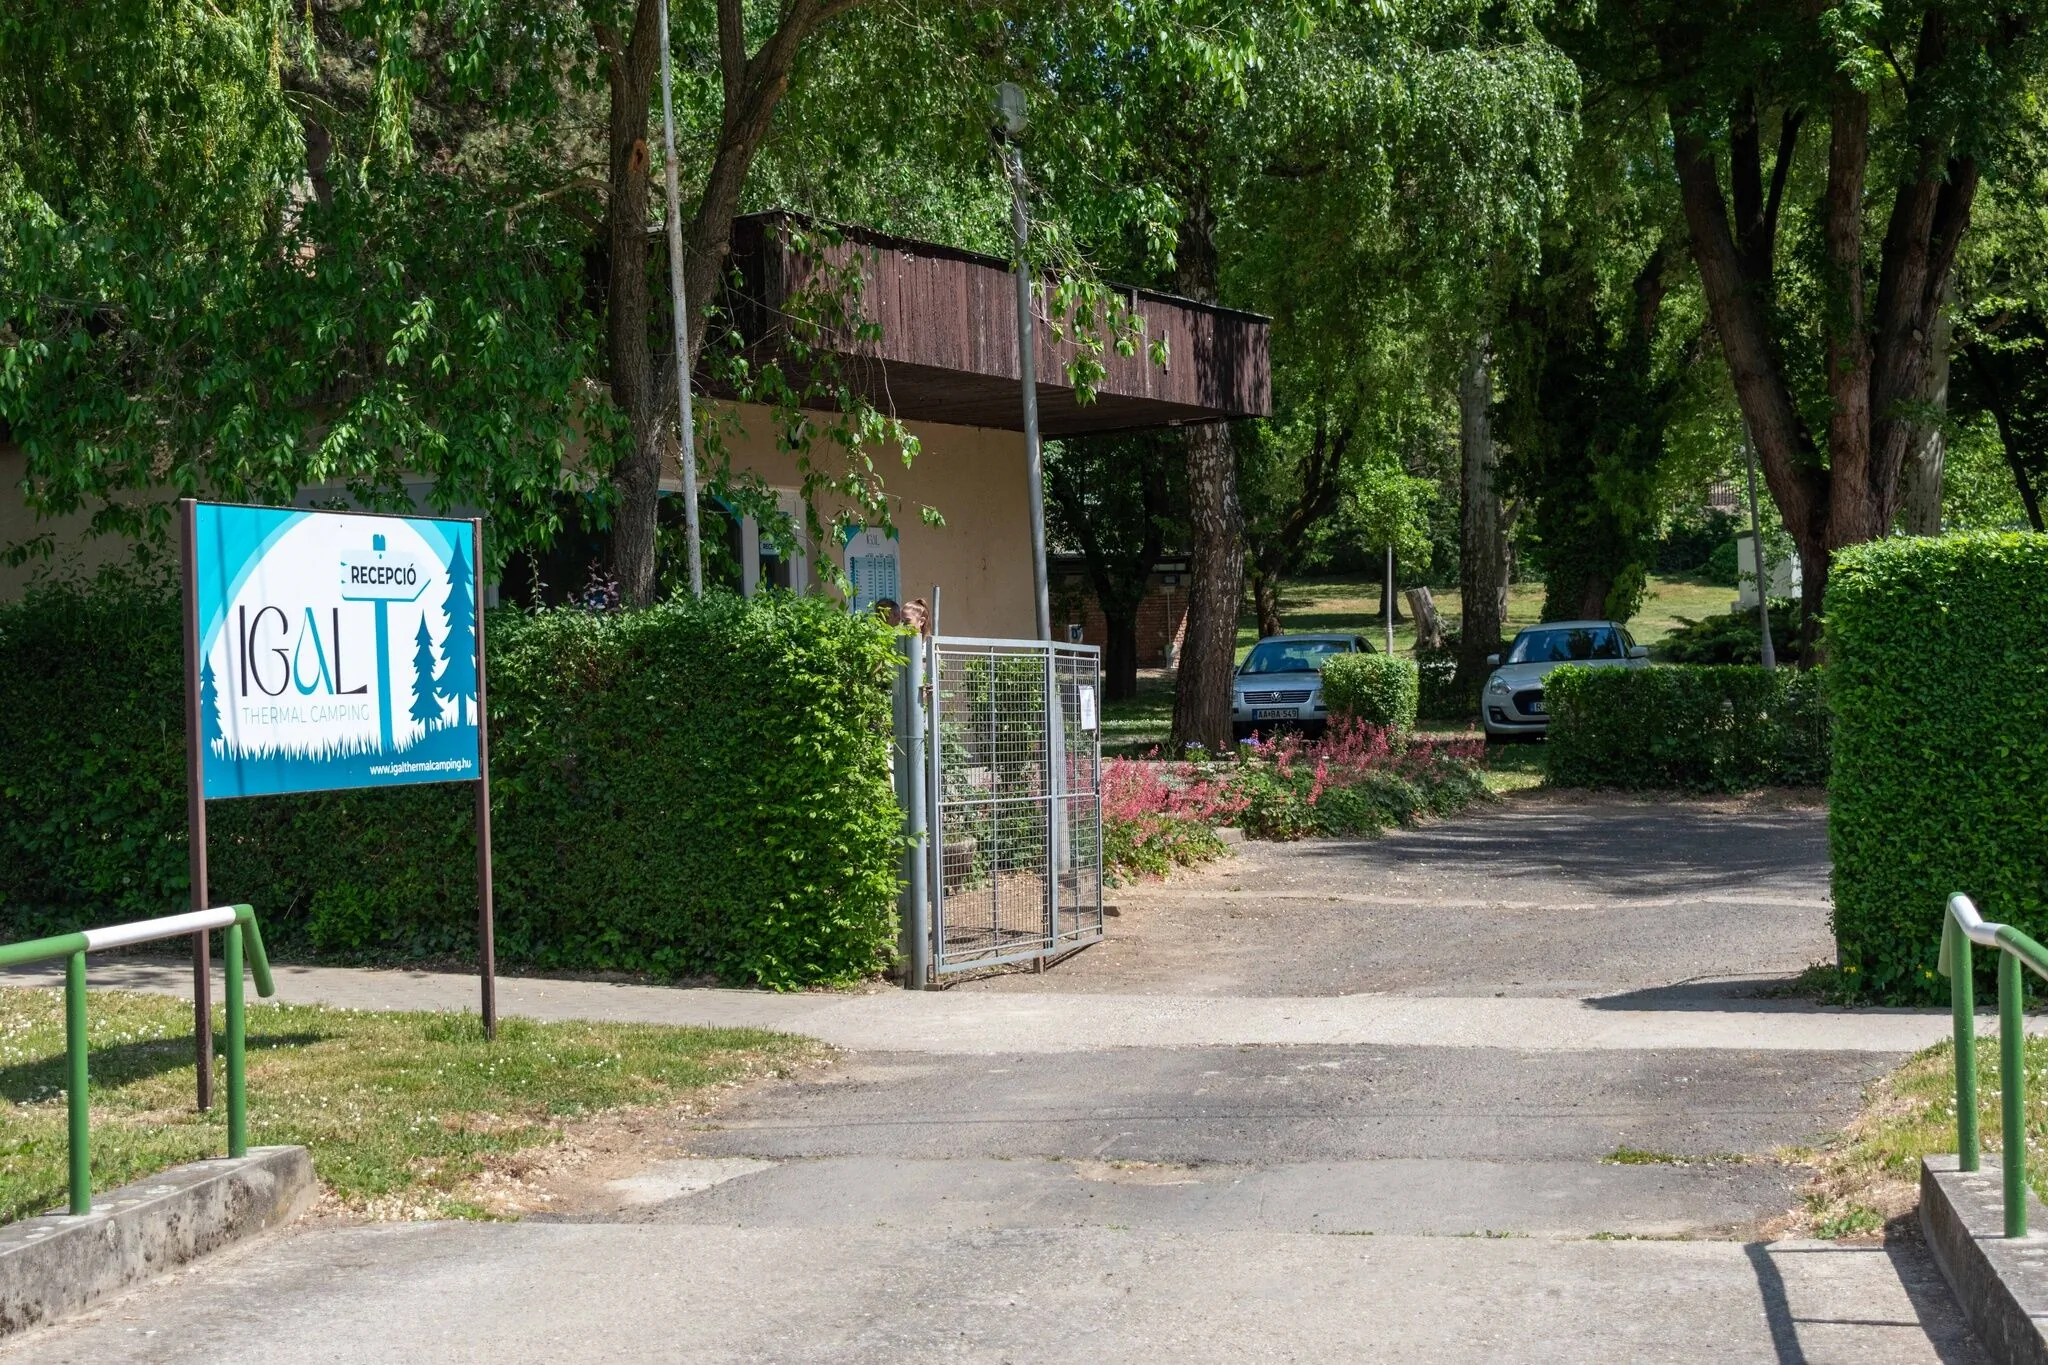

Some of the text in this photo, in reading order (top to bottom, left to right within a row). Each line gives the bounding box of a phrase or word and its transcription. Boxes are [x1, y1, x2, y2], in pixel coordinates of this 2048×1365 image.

[351, 563, 417, 586] RECEPCIÓ
[239, 605, 368, 697] IGAL
[242, 704, 370, 725] THERMAL CAMPING
[369, 758, 472, 776] www.igalthermalcamping.hu
